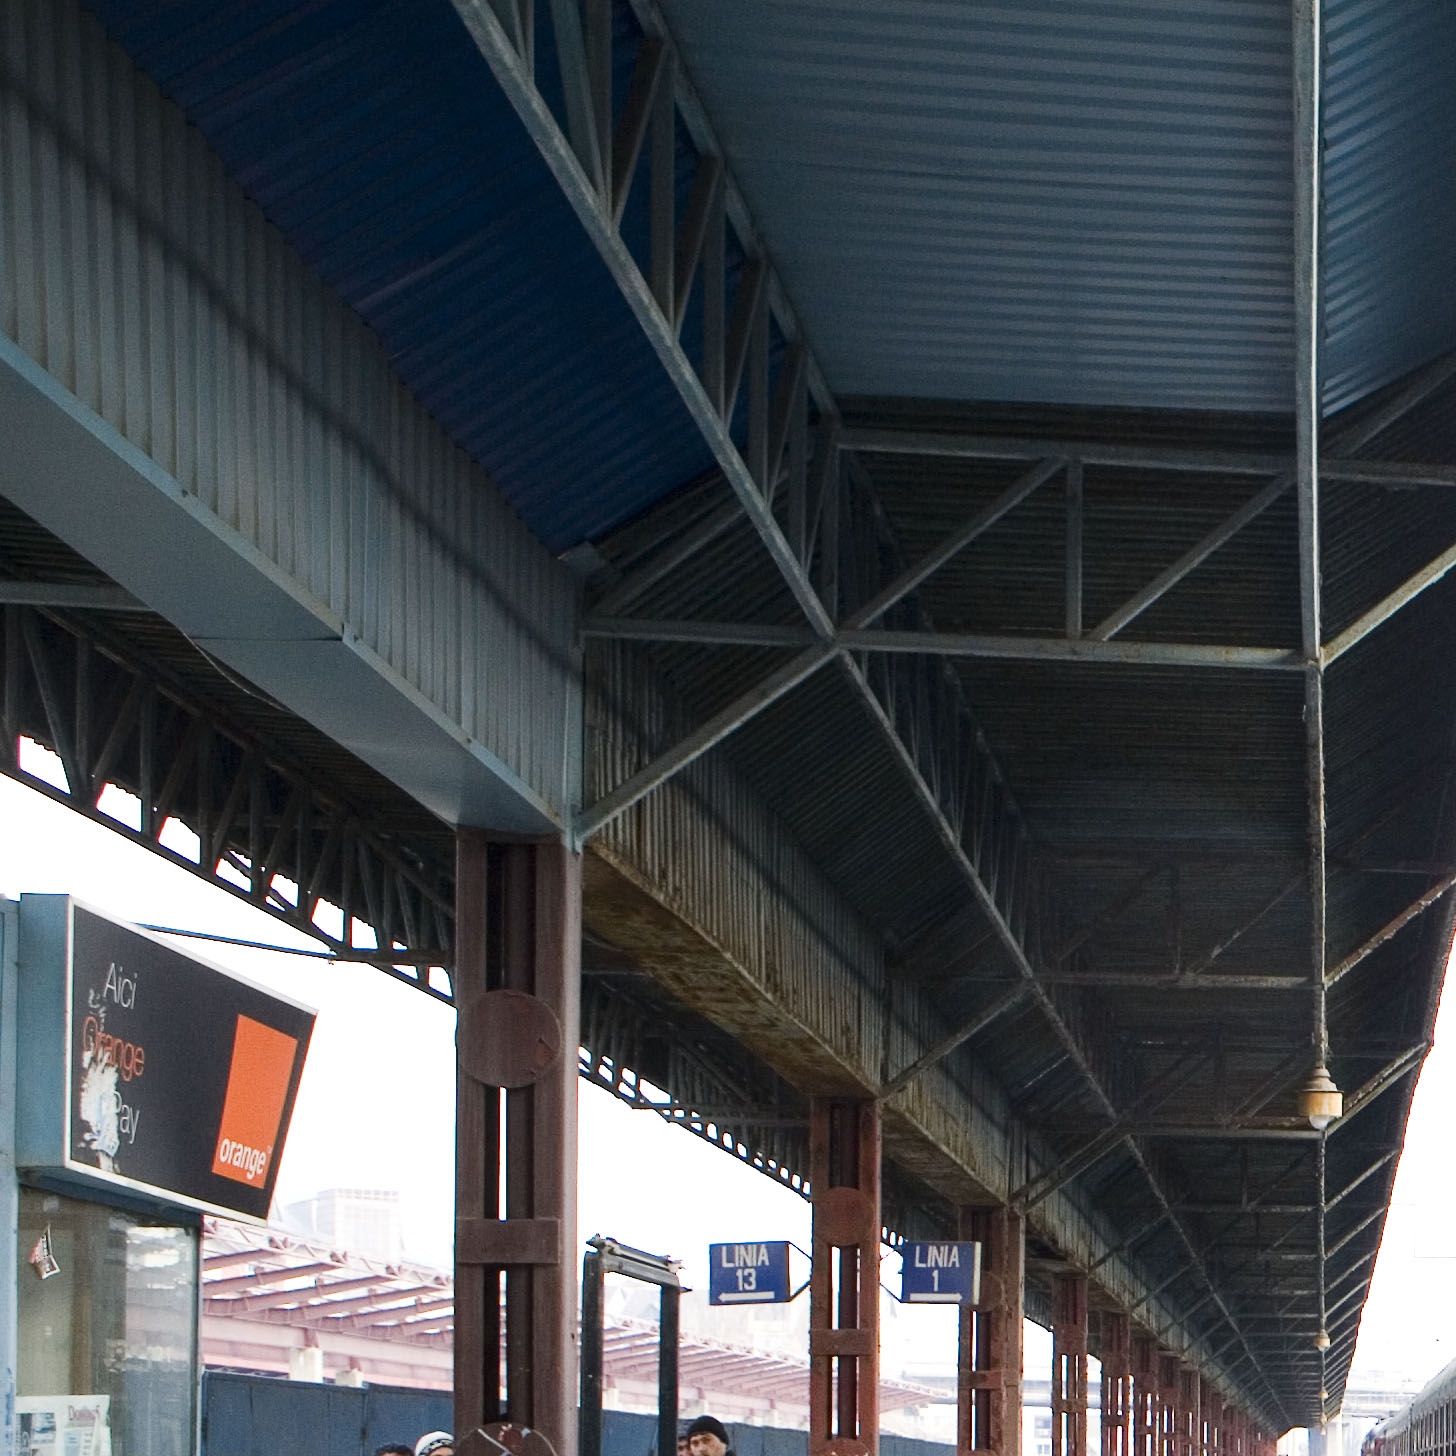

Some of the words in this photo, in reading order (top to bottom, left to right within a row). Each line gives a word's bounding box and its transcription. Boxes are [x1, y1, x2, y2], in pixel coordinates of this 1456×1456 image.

[102, 962, 139, 1009] Aici
[82, 1015, 145, 1082] Orange
[219, 1137, 268, 1180] orange
[721, 1244, 770, 1268] LINIA
[914, 1245, 960, 1268] LINIA
[735, 1268, 757, 1291] 13
[931, 1269, 940, 1291] 1
